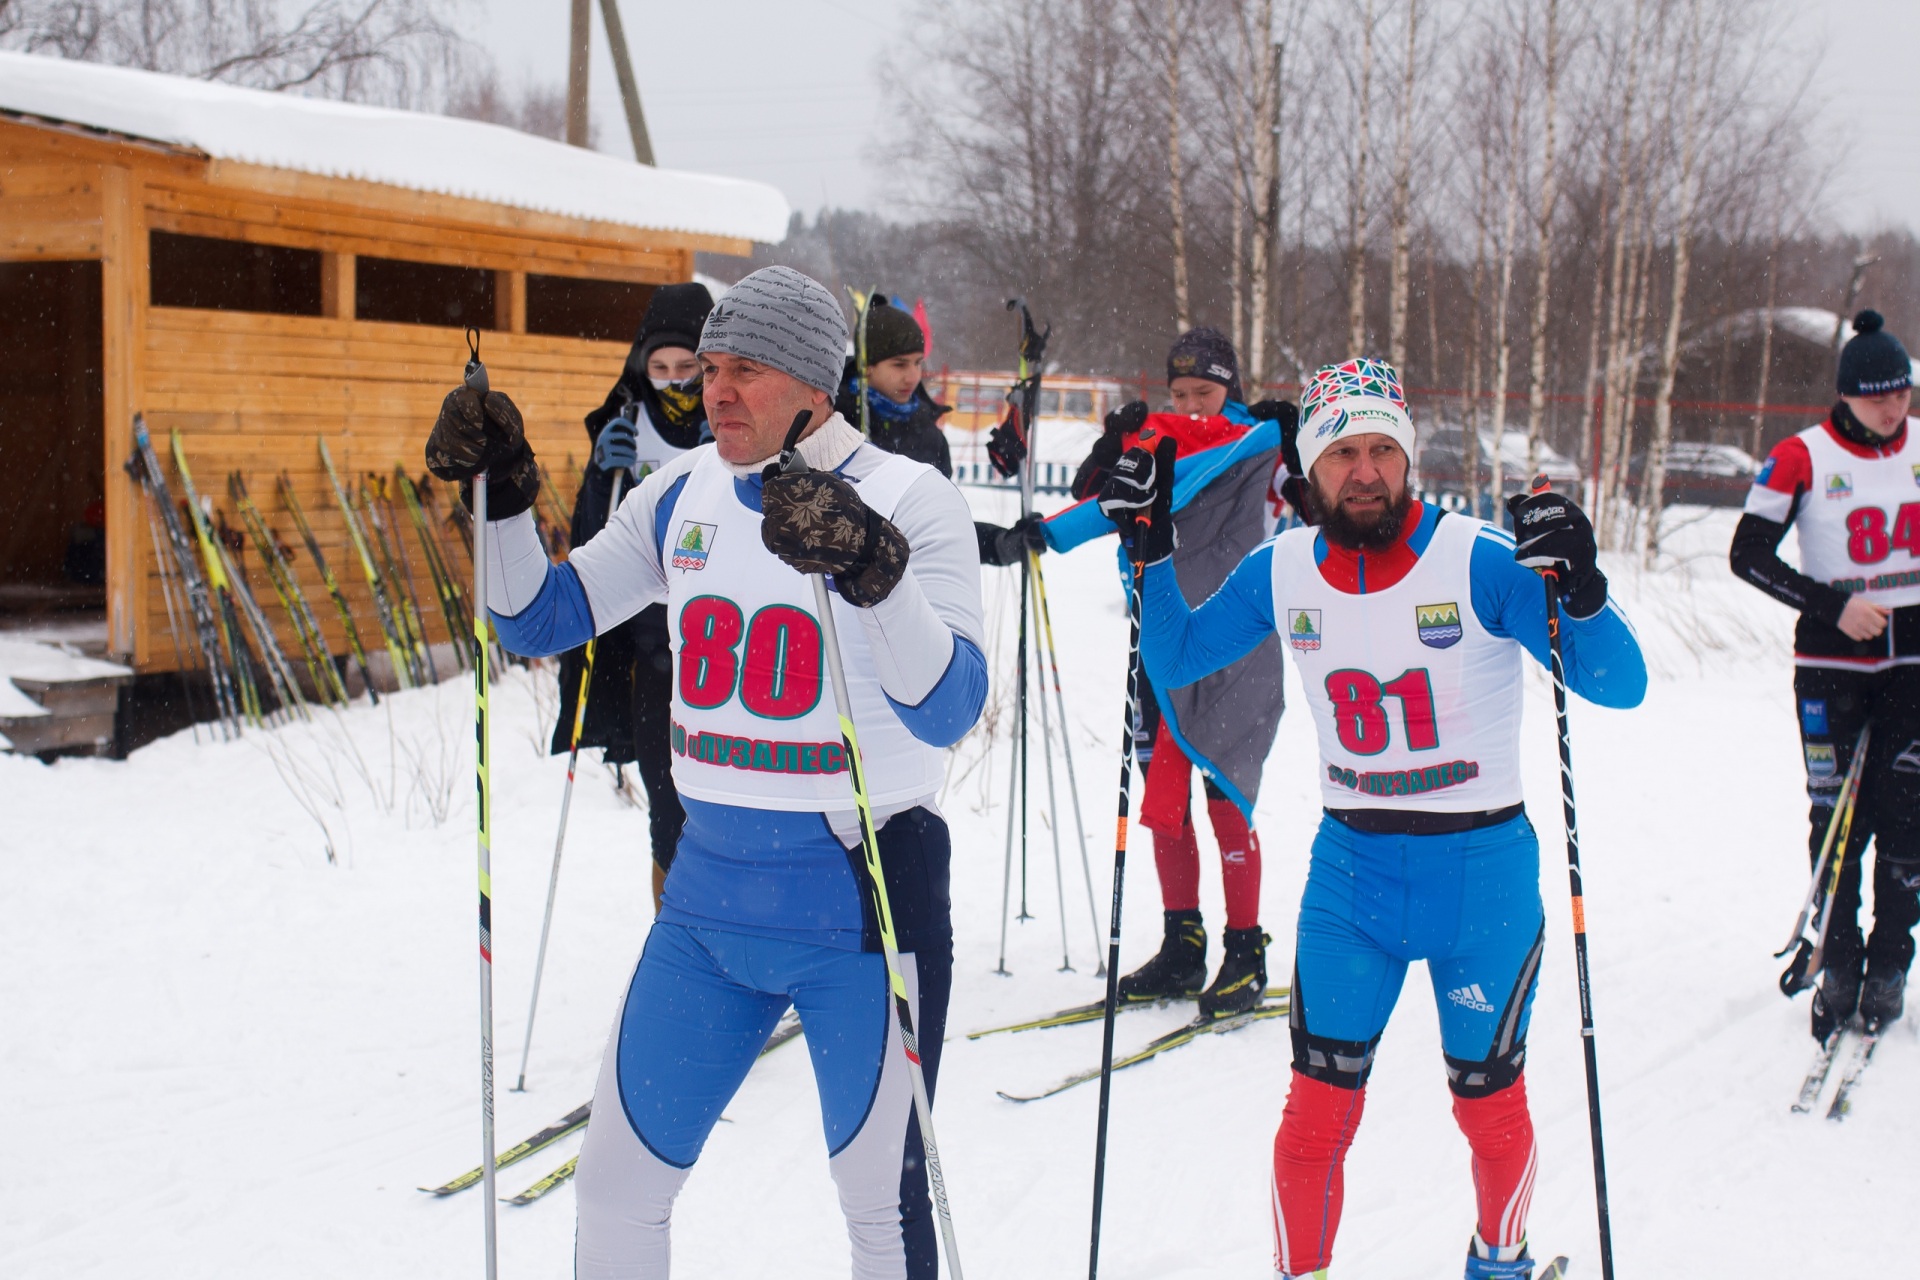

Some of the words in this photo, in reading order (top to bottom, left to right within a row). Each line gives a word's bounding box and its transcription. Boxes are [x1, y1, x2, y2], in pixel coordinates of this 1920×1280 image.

[703, 330, 728, 339] adidas
[1846, 502, 1920, 564] 84
[679, 594, 824, 720] 80
[1324, 667, 1440, 756] 81
[1447, 991, 1495, 1013] adidas
[483, 1036, 494, 1121] AVANTI
[447, 1142, 531, 1190] FISHER
[924, 1137, 951, 1221] AVANTI
